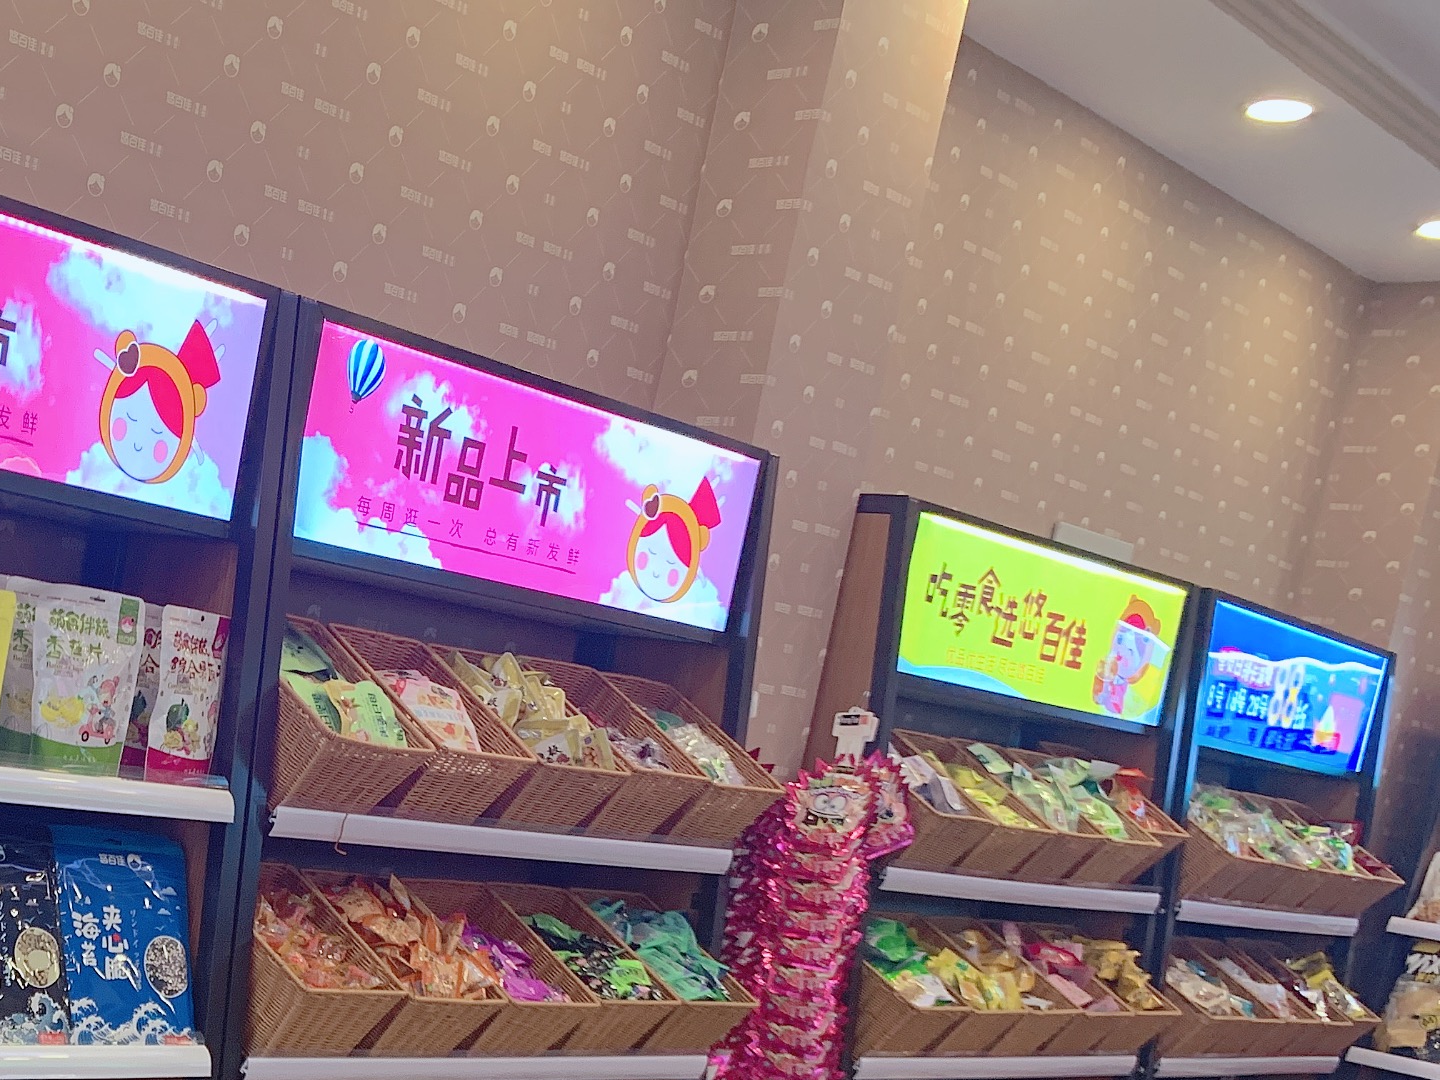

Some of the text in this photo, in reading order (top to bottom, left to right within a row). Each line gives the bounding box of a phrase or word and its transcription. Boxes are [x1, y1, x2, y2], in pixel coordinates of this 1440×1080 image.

[394, 394, 568, 527] 新品上市
[355, 495, 464, 539] 每周逛一次
[925, 562, 1087, 670] 吃零食选悠百佳
[72, 911, 101, 967] 海苔
